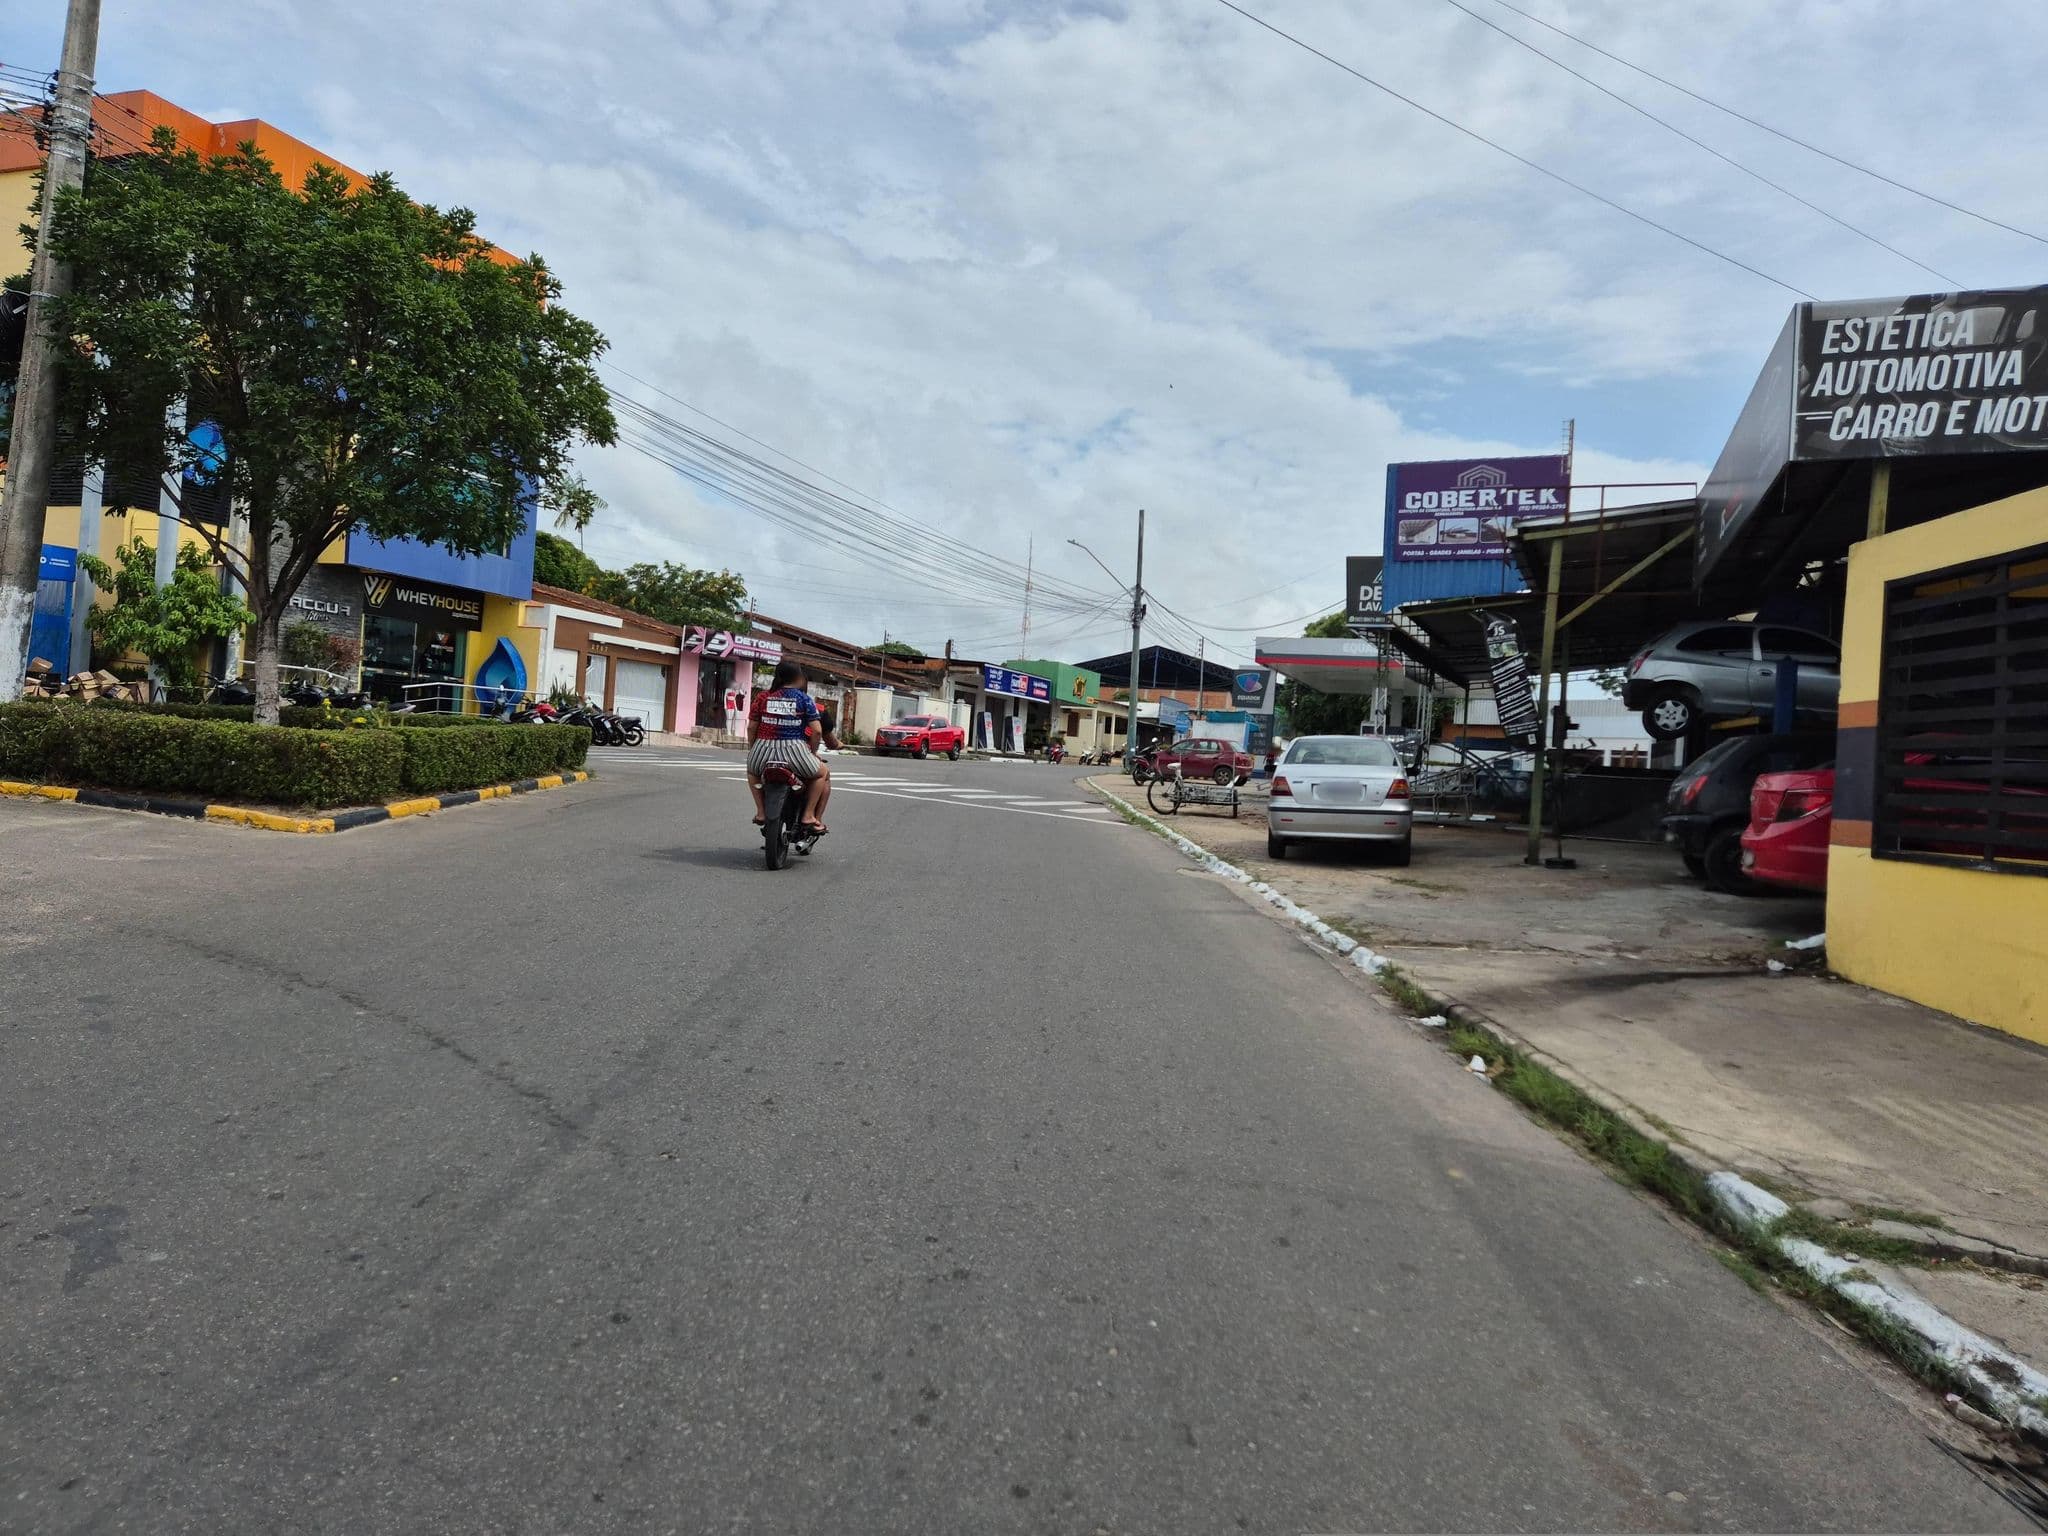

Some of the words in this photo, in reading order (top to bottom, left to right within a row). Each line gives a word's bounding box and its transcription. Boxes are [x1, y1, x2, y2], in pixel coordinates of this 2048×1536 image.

[1811, 349, 2024, 398] AUTOMOTIVA
[1829, 401, 1941, 441] CARRO
[1944, 400, 1971, 436] E
[289, 596, 351, 616] ACQUA
[395, 587, 480, 614] WHEYHOUSE
[1359, 601, 1383, 612] LAV
[734, 635, 782, 652] DETONE
[1499, 675, 1520, 690] MOTOR
